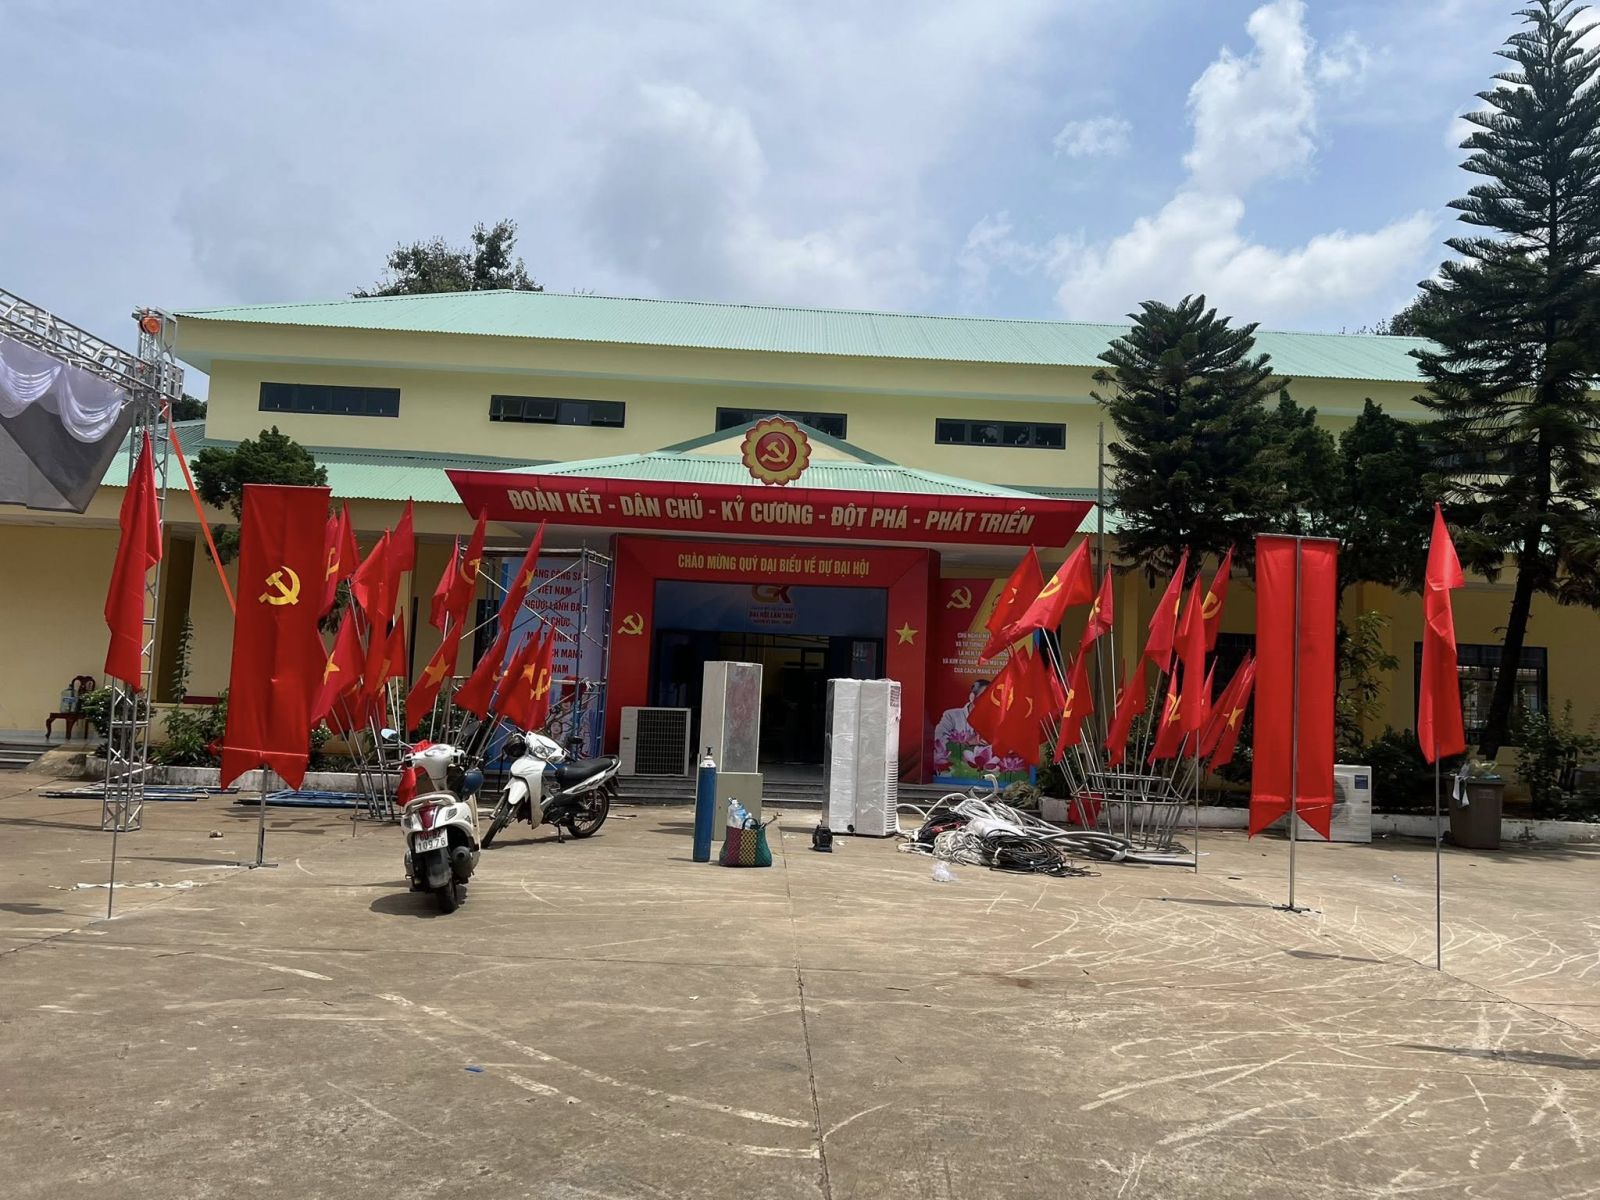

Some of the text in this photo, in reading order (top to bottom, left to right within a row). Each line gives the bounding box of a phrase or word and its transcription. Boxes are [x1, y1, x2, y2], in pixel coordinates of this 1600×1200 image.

[507, 486, 565, 512] ĐOÀN
[566, 487, 602, 514] KẾT
[620, 492, 662, 518] DÂN
[665, 492, 703, 520] CHỦ
[722, 494, 745, 522] KỶ
[751, 501, 813, 525] CƯƠNG
[831, 503, 867, 531] ĐỘT
[870, 505, 908, 529] PHÁ
[925, 507, 976, 532] PHÁT
[978, 506, 1036, 535] TRIỂN
[678, 552, 704, 569] CHÀO
[707, 553, 737, 570] MỪNG
[739, 554, 758, 572] QUÝ
[760, 558, 777, 576] ĐẠI
[818, 558, 833, 577] DỰ
[834, 560, 851, 578] ĐẠI
[853, 559, 870, 578] HỘI
[555, 586, 572, 596] NAM
